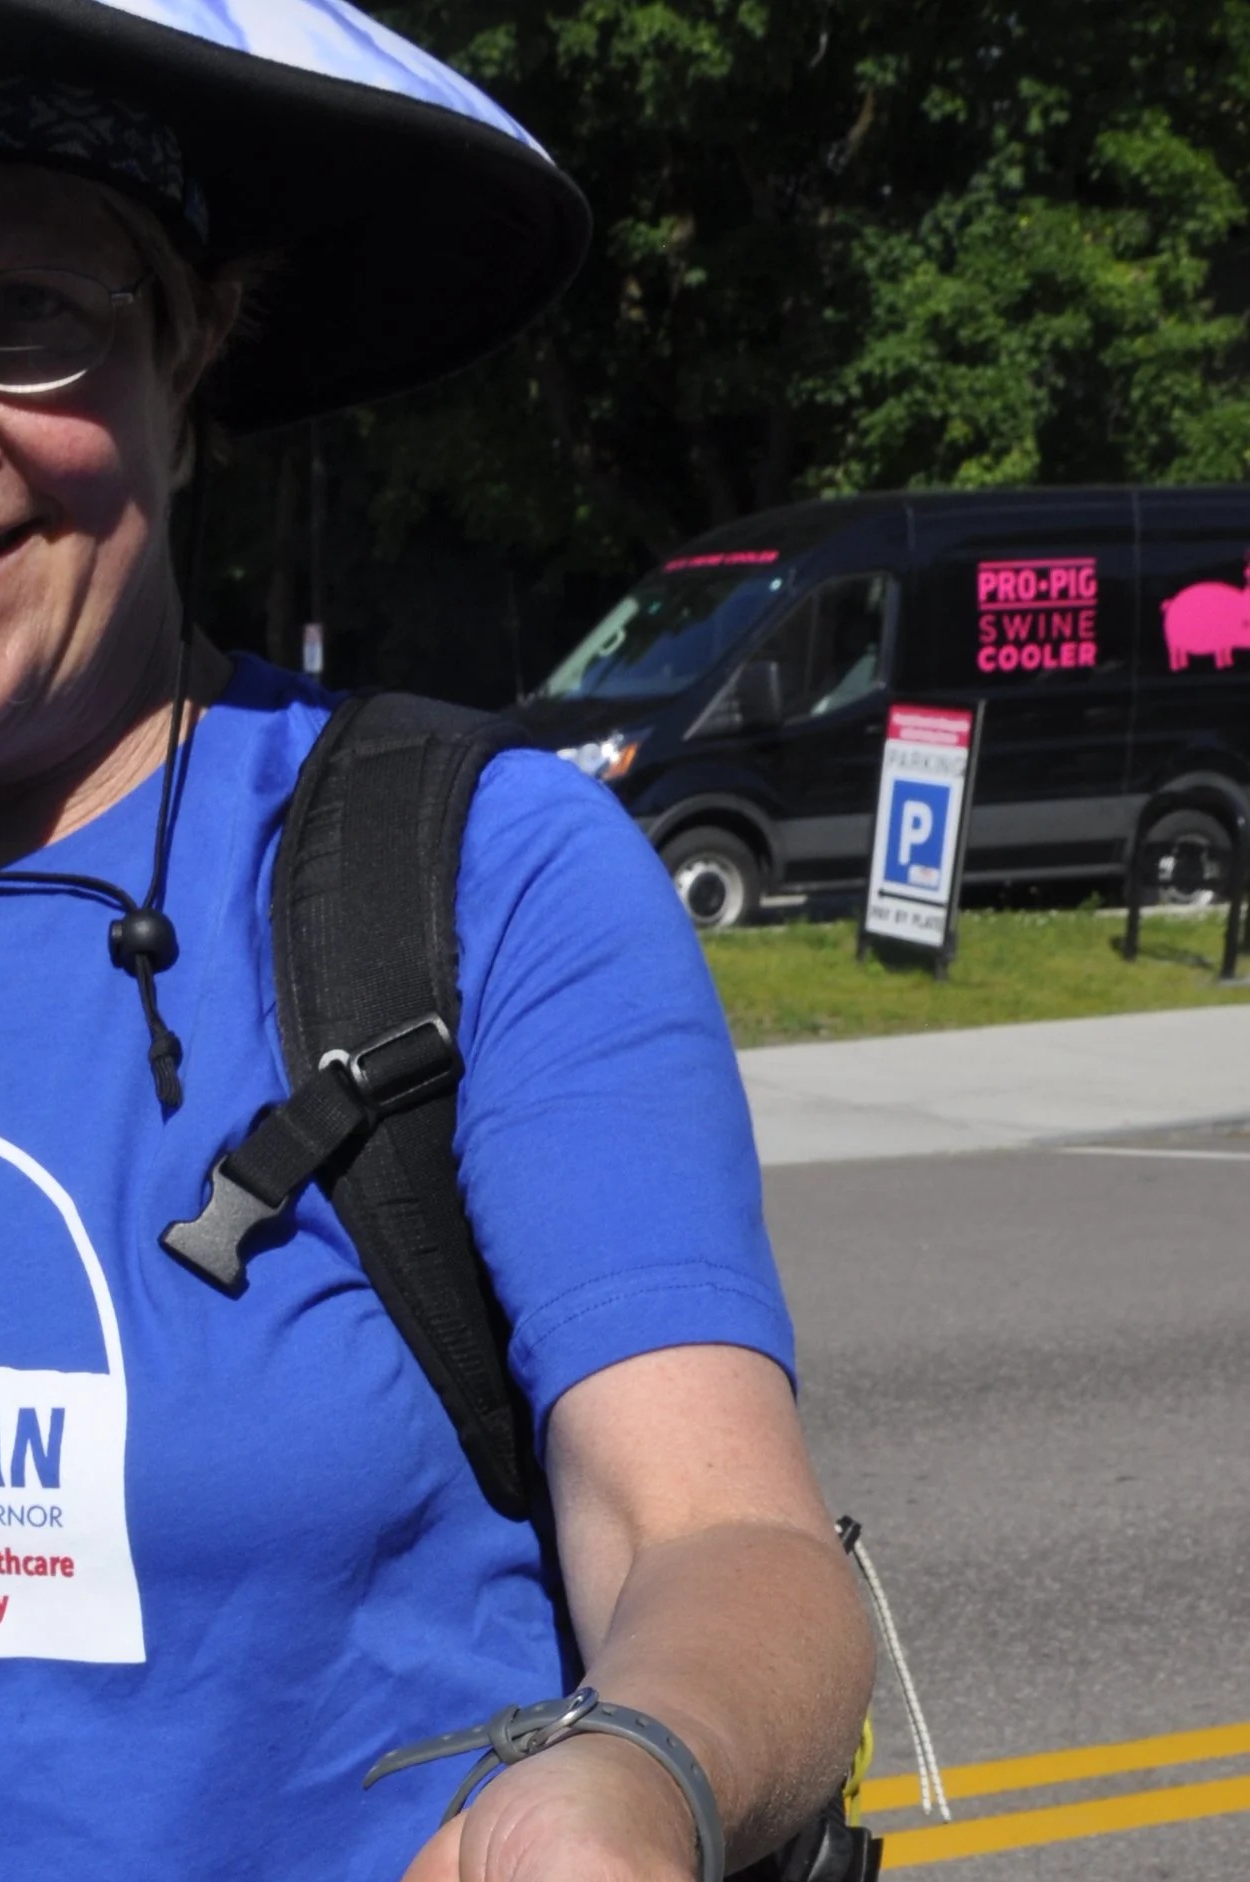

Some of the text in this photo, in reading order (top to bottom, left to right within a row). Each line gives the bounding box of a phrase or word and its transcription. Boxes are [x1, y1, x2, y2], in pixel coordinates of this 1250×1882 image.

[978, 610, 1096, 643] SWINE
[977, 642, 1097, 672] COOLER
[898, 800, 933, 866] P
